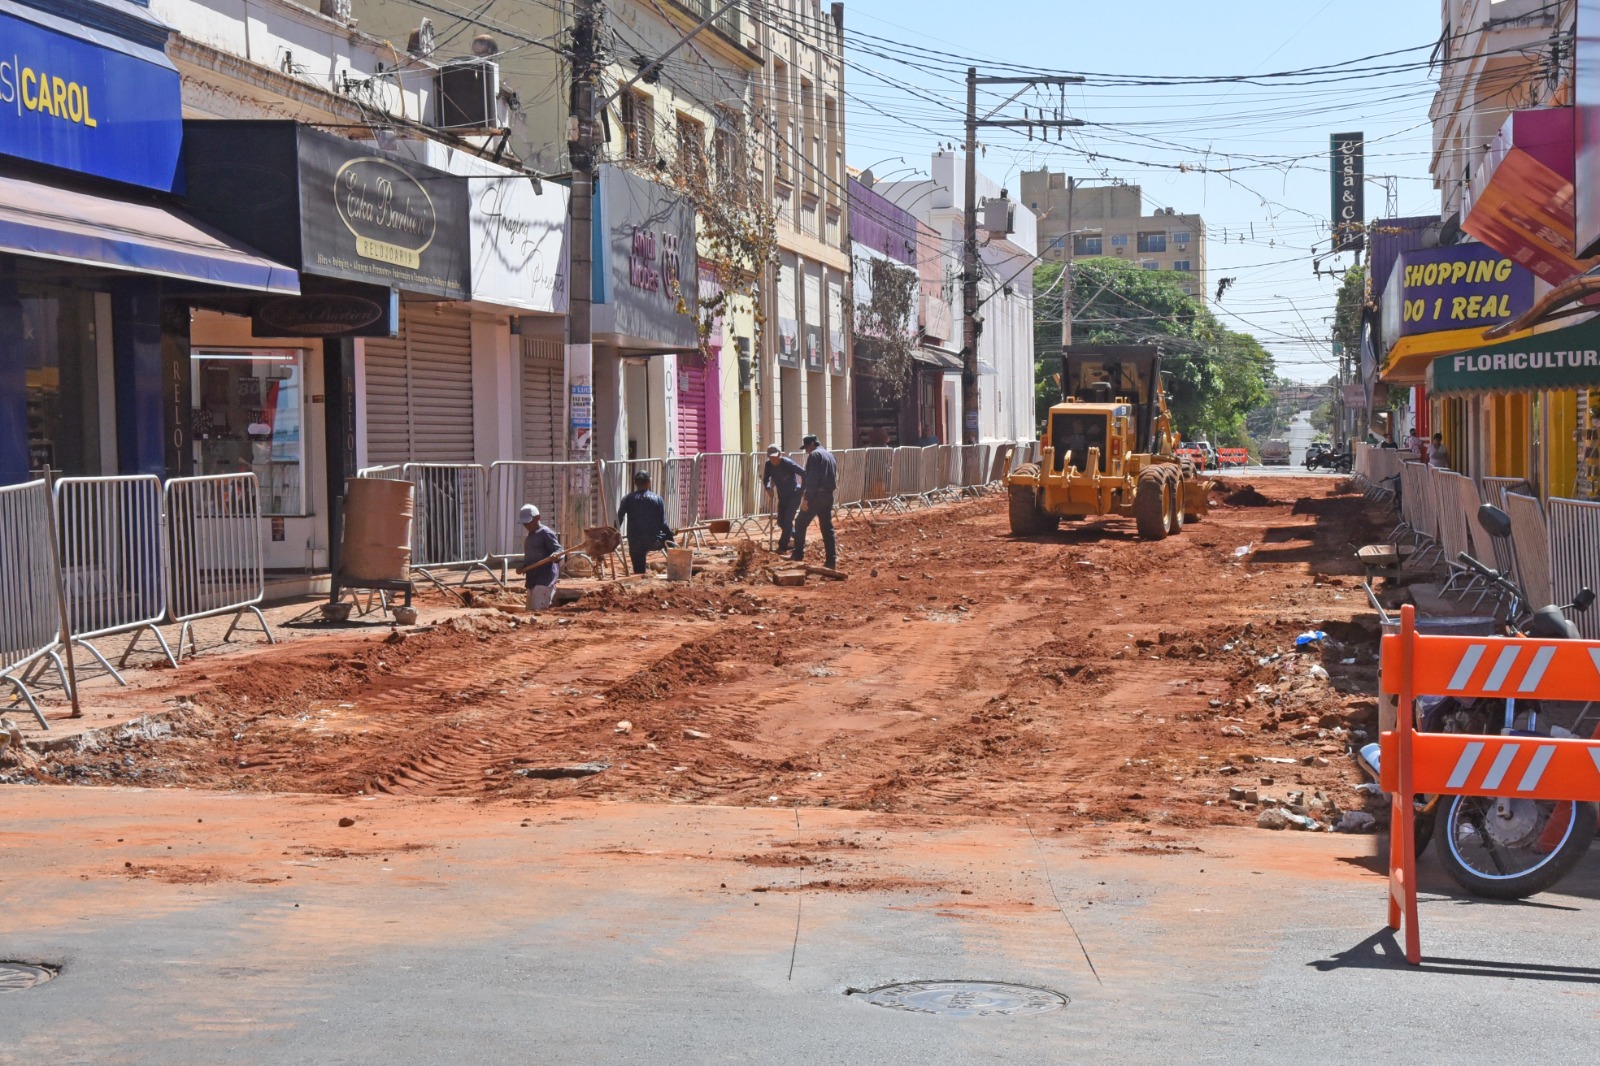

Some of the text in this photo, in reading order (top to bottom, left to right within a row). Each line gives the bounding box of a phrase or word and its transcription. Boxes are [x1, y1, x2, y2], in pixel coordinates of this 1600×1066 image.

[21, 67, 97, 128] CAROL
[363, 240, 414, 265] RELOJOARIA
[1403, 258, 1513, 288] SHOPPING
[1403, 294, 1512, 322] DO 1 REAL
[1453, 350, 1600, 372] FLORICULTUR
